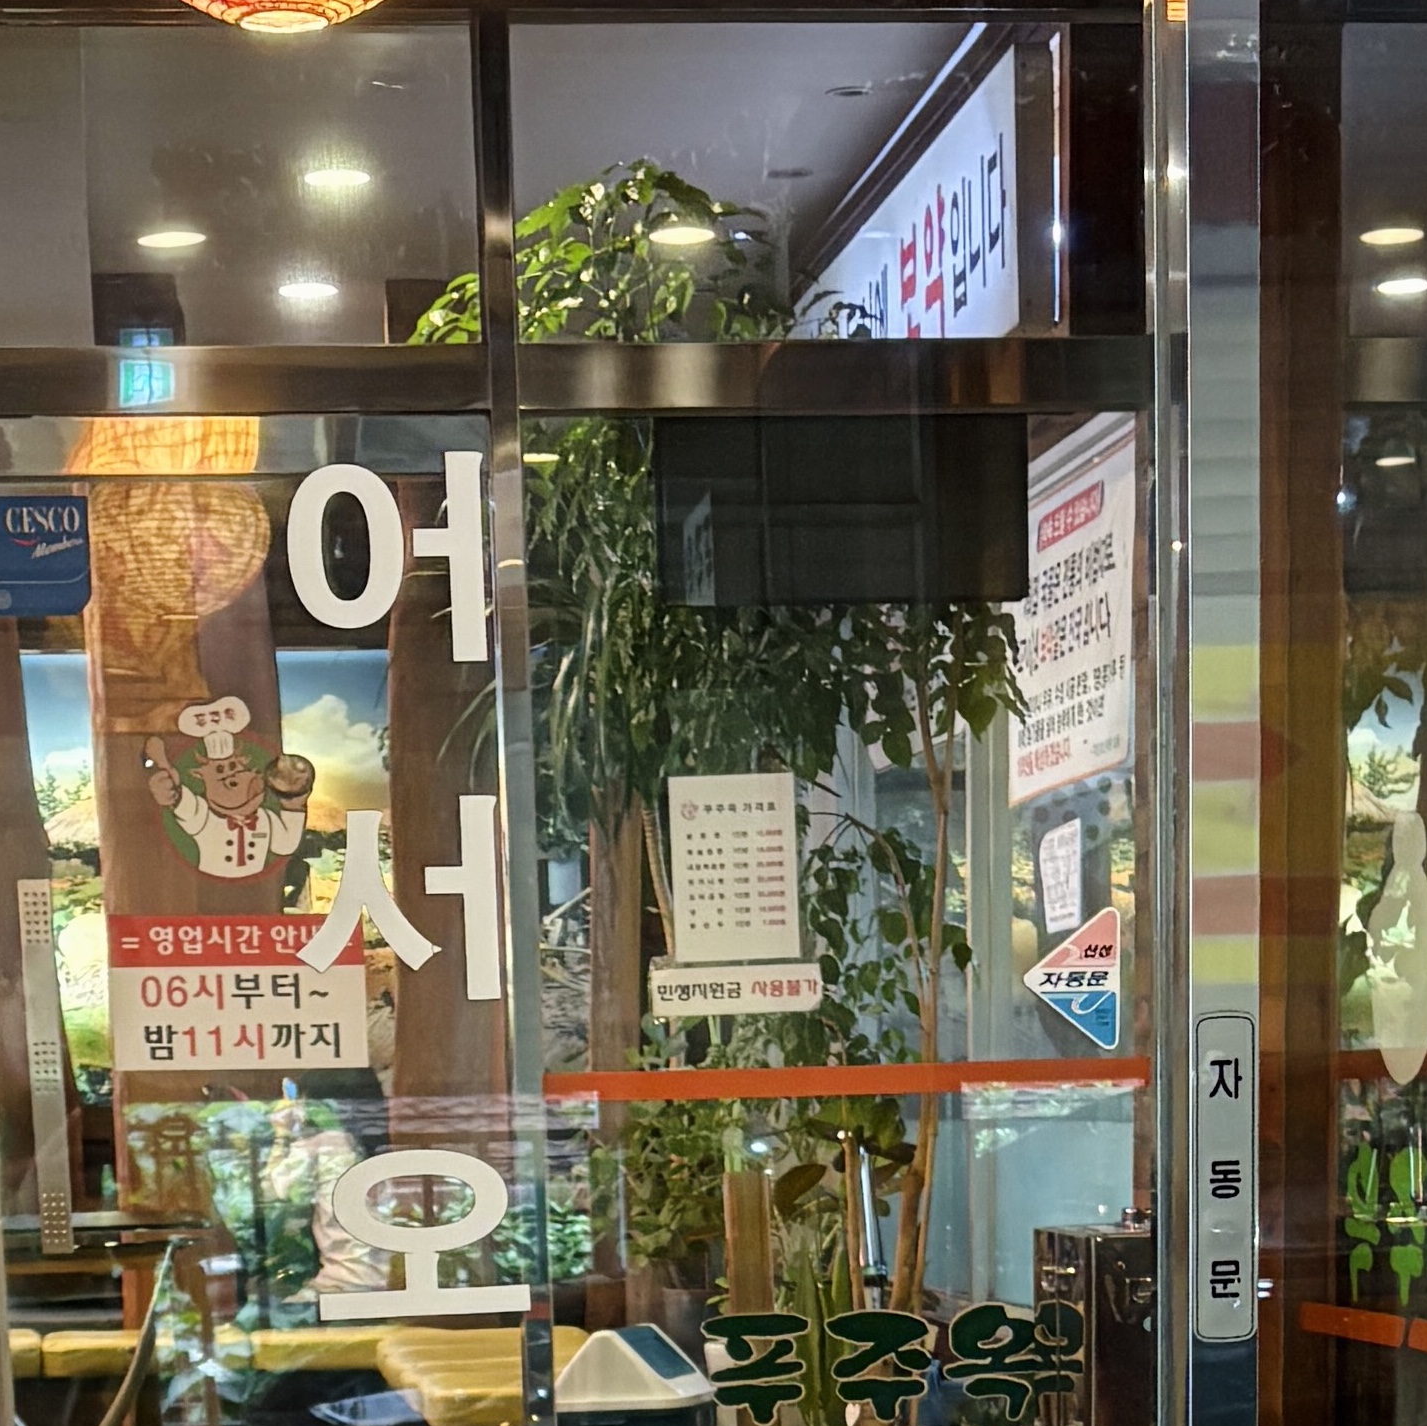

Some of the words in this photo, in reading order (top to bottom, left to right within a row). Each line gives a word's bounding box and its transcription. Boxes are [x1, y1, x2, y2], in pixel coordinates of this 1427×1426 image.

[5, 506, 80, 534] CESCO
[148, 925, 263, 956] 영업시간
[140, 972, 330, 1010] 06시부터~
[656, 981, 742, 1002] 민생지원금
[750, 978, 819, 998] 사용불가
[1039, 971, 1109, 988] 자동문
[143, 1022, 342, 1061] 밤11시까지
[1208, 1057, 1243, 1299] 자동문
